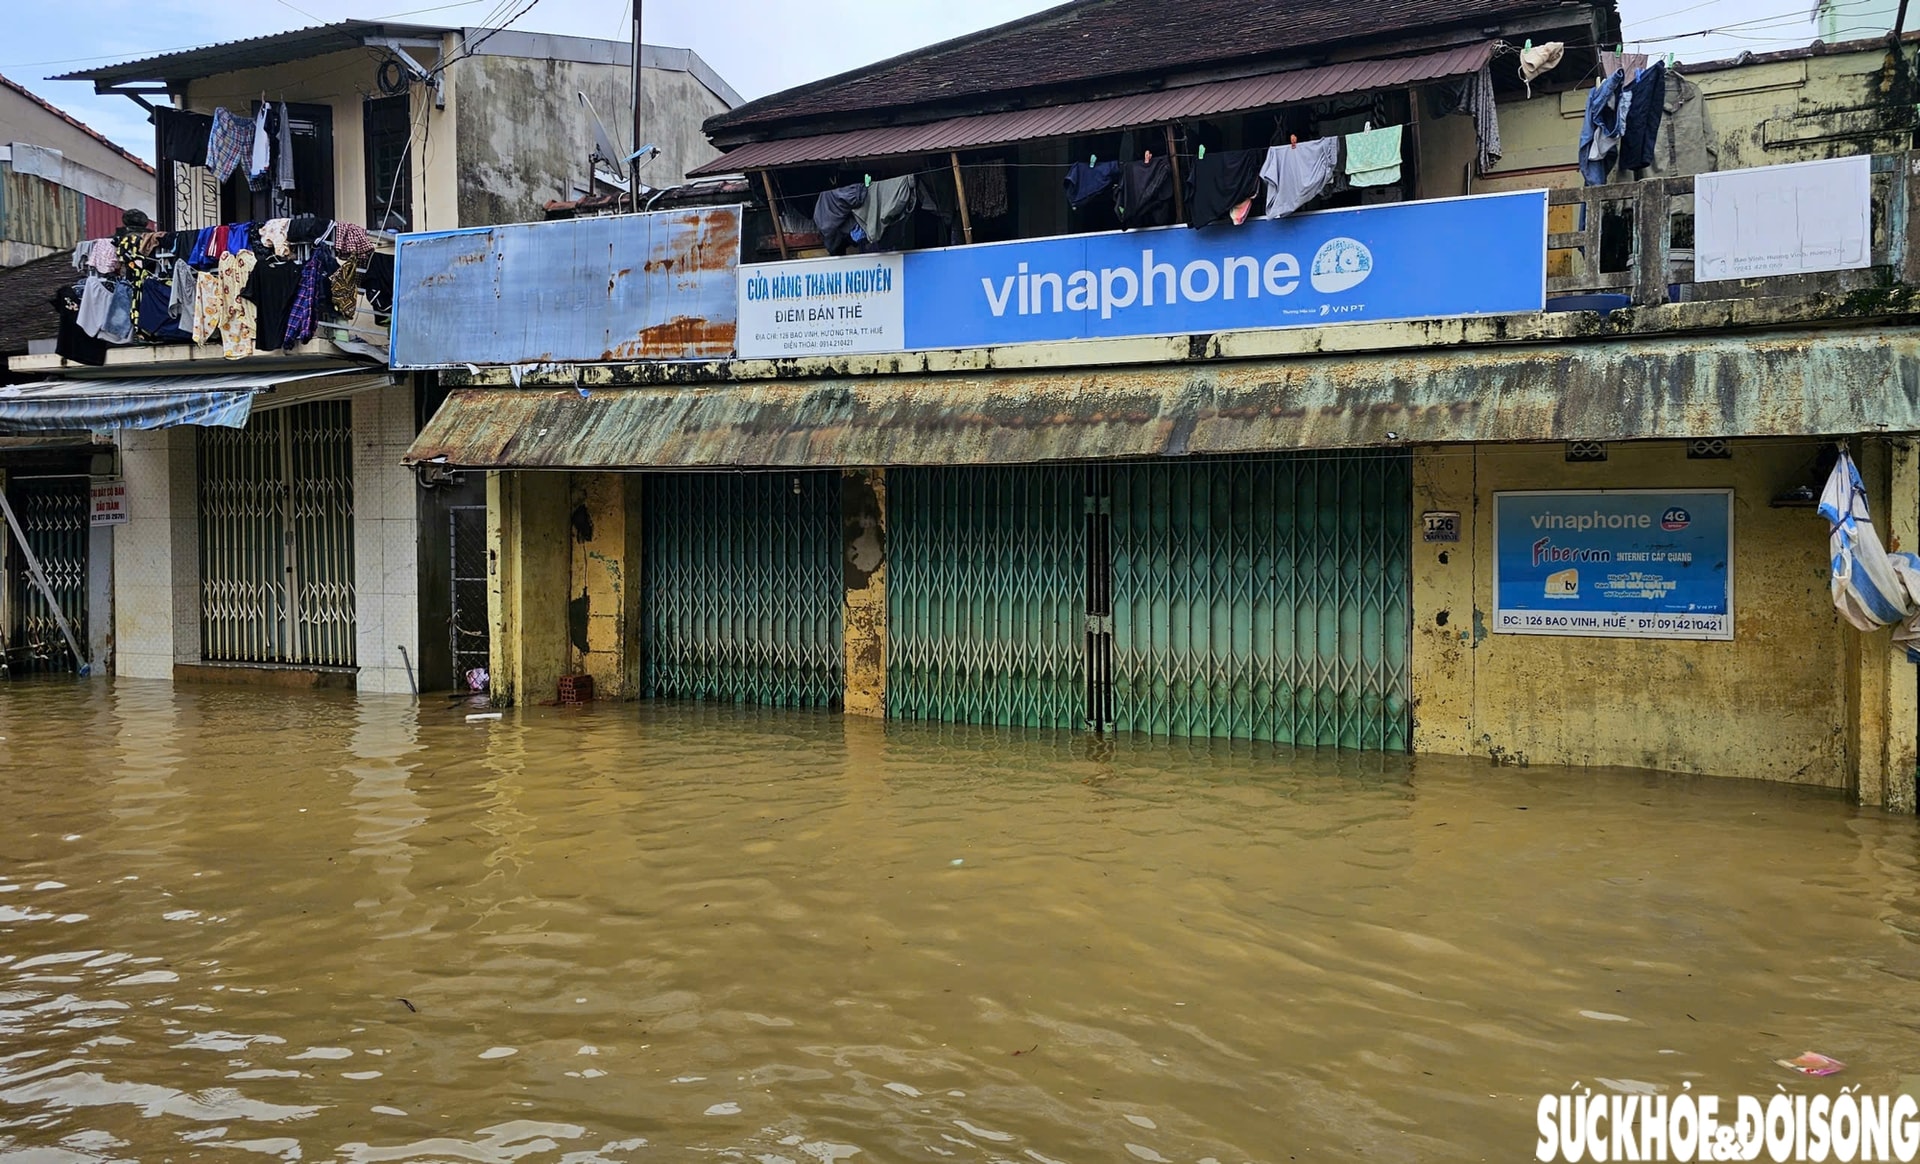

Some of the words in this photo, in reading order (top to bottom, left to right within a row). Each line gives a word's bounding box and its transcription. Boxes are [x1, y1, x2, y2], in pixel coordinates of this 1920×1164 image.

[747, 270, 770, 301] CỬA
[772, 271, 802, 300] HÀNG
[805, 271, 842, 297] THANH
[845, 263, 892, 294] NGUYÊN
[981, 249, 1300, 320] vinaphone
[808, 304, 835, 321] BÁN
[838, 302, 863, 320] THẺ
[1332, 304, 1365, 313] VNPT
[790, 330, 803, 339] BAO
[1531, 510, 1651, 532] vinaphone
[1664, 510, 1686, 522] 4G
[1428, 518, 1454, 530] 126
[1616, 552, 1650, 562] INTERNET
[1667, 552, 1692, 562] QUANG
[1629, 572, 1643, 581] TV
[1503, 616, 1522, 626] ĐC:
[1525, 616, 1542, 626] 126
[1546, 616, 1568, 626] BAO
[1570, 617, 1600, 628] VINH,
[1603, 614, 1626, 628] HUẾ
[1638, 619, 1656, 628] ĐT:
[1658, 620, 1722, 630] 0914210421
